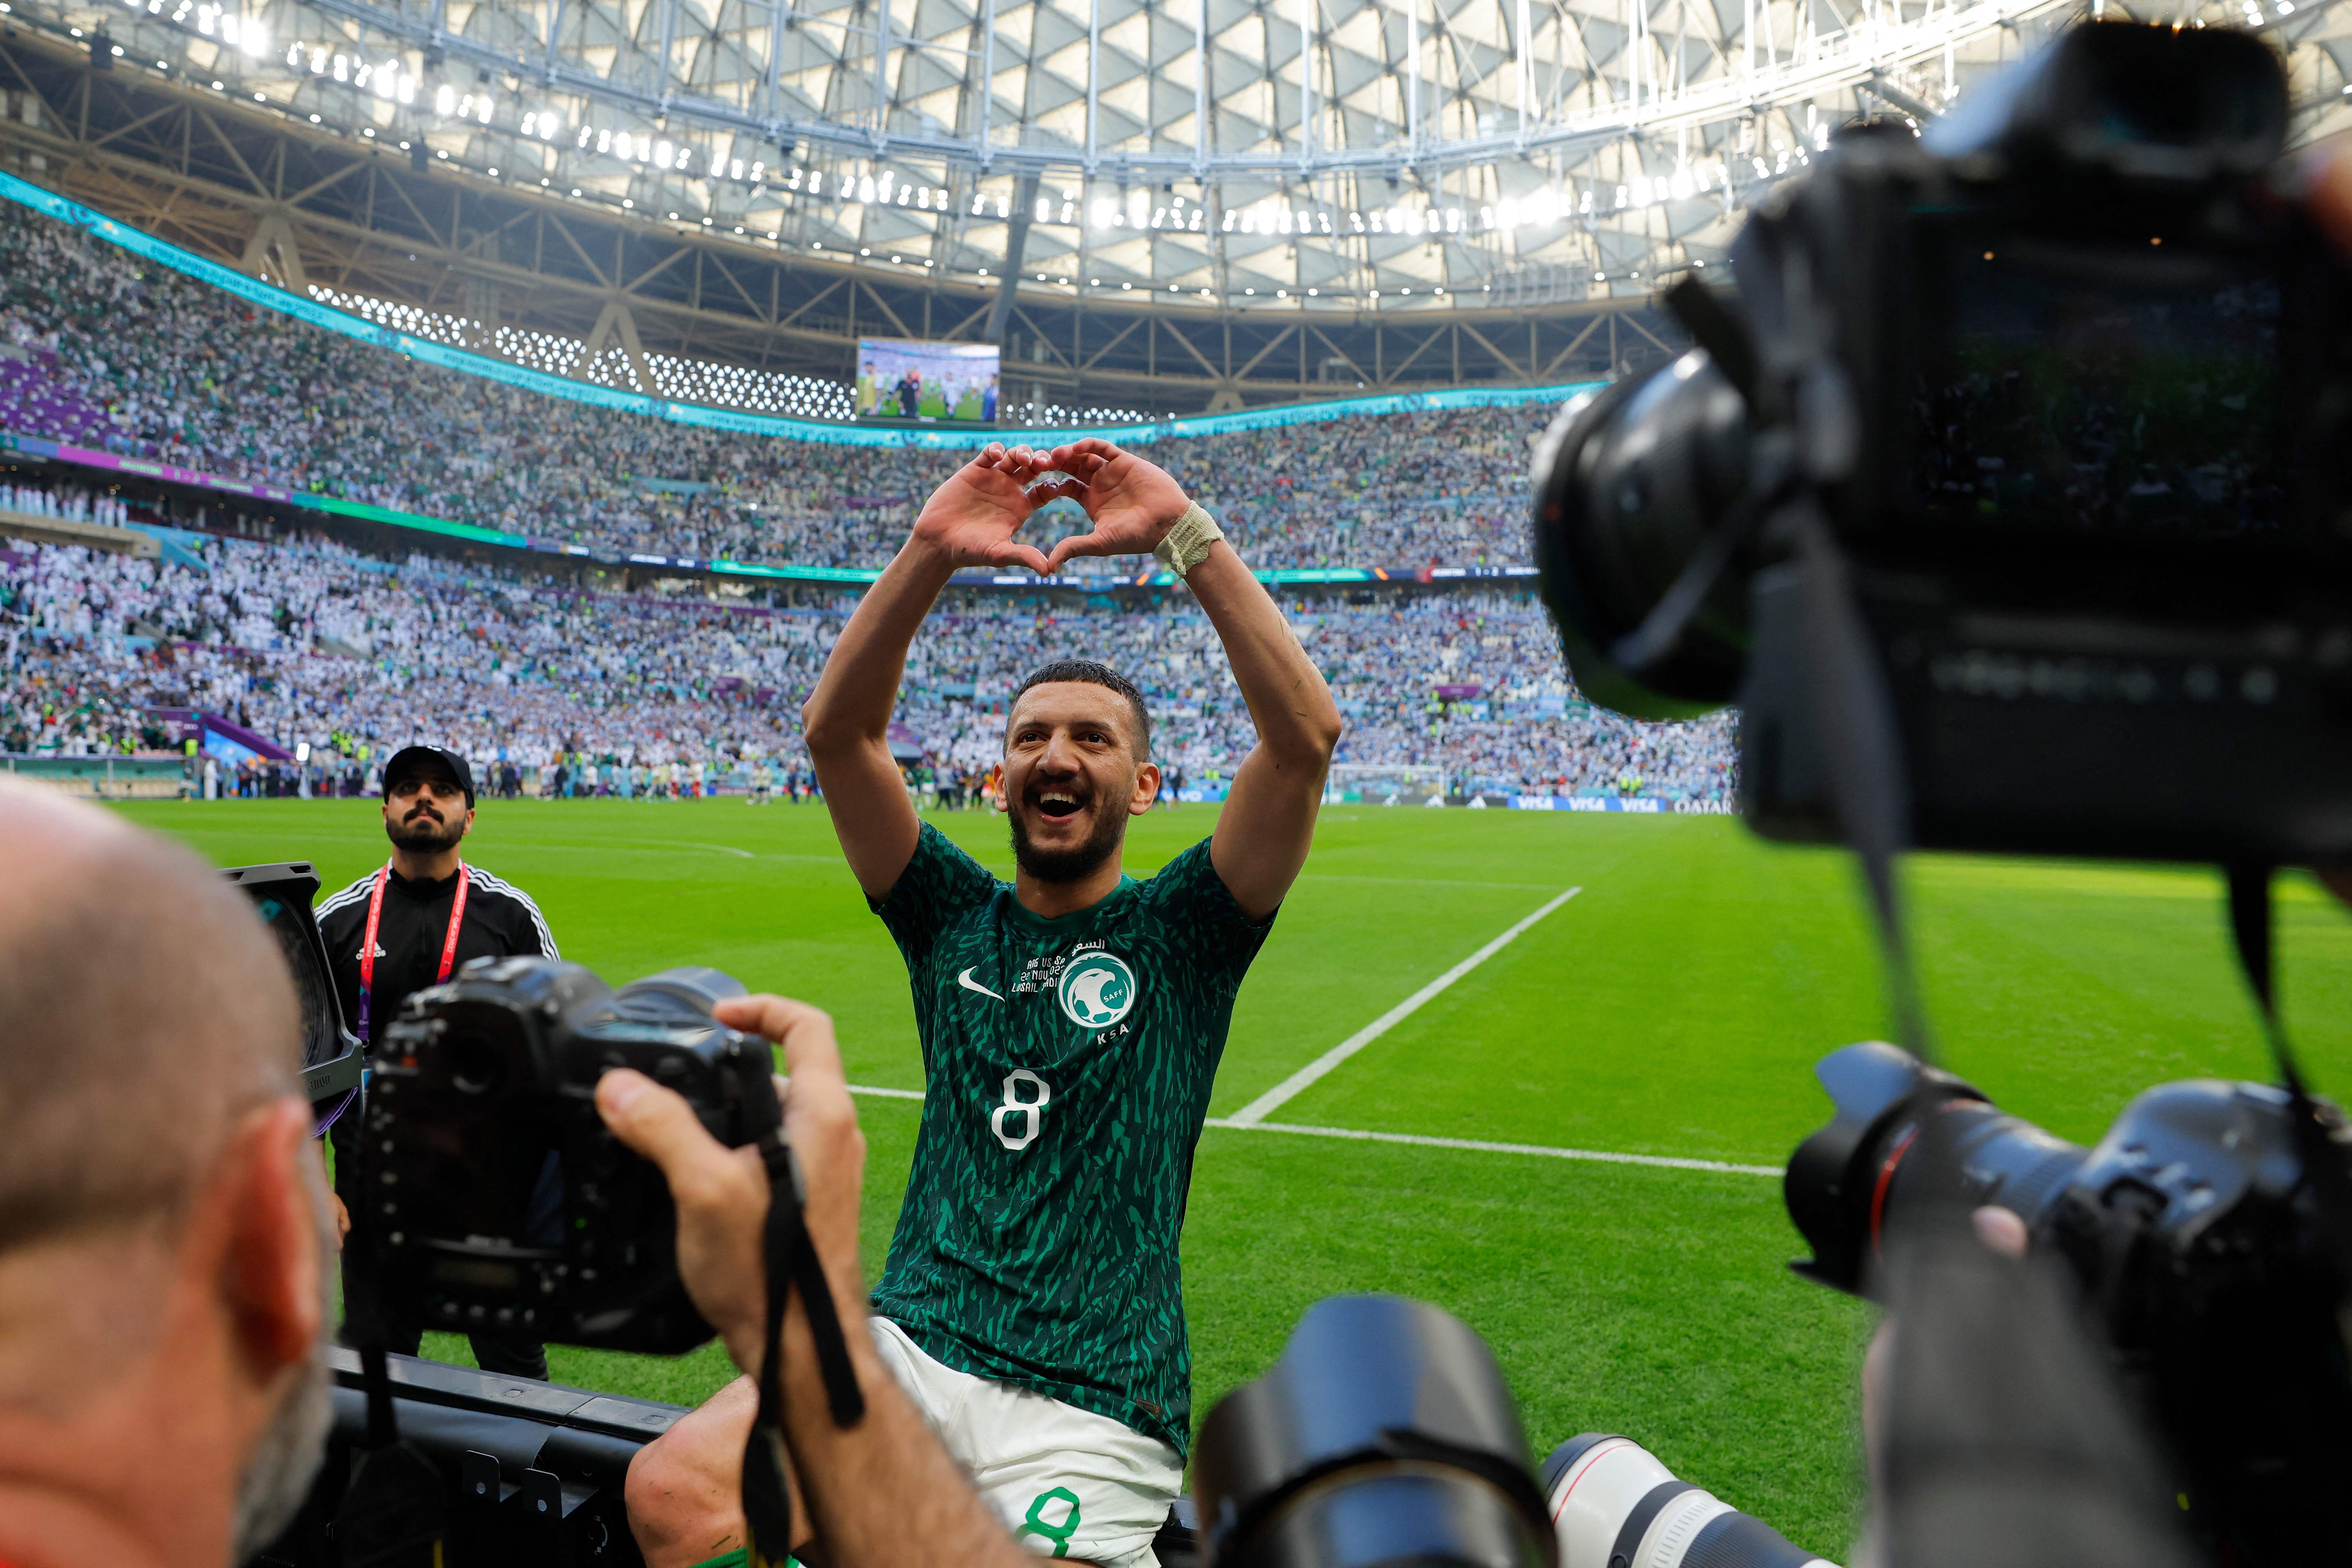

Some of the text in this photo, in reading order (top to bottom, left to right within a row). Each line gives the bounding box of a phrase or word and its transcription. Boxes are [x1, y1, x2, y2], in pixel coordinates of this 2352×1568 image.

[1161, 789, 1203, 803] vvo
[1518, 796, 1554, 811] VISA
[1568, 797, 1606, 811] VISA
[1620, 798, 1659, 813] VISA
[1673, 798, 1732, 815] QATAR
[1027, 958, 1039, 970] ARG
[1020, 972, 1030, 982] 22
[1011, 982, 1038, 993] LUSAIL
[1103, 989, 1123, 1003] SAFF
[1097, 1023, 1129, 1045] KSA
[991, 1069, 1051, 1150] 8
[1014, 1486, 1081, 1558] 8
